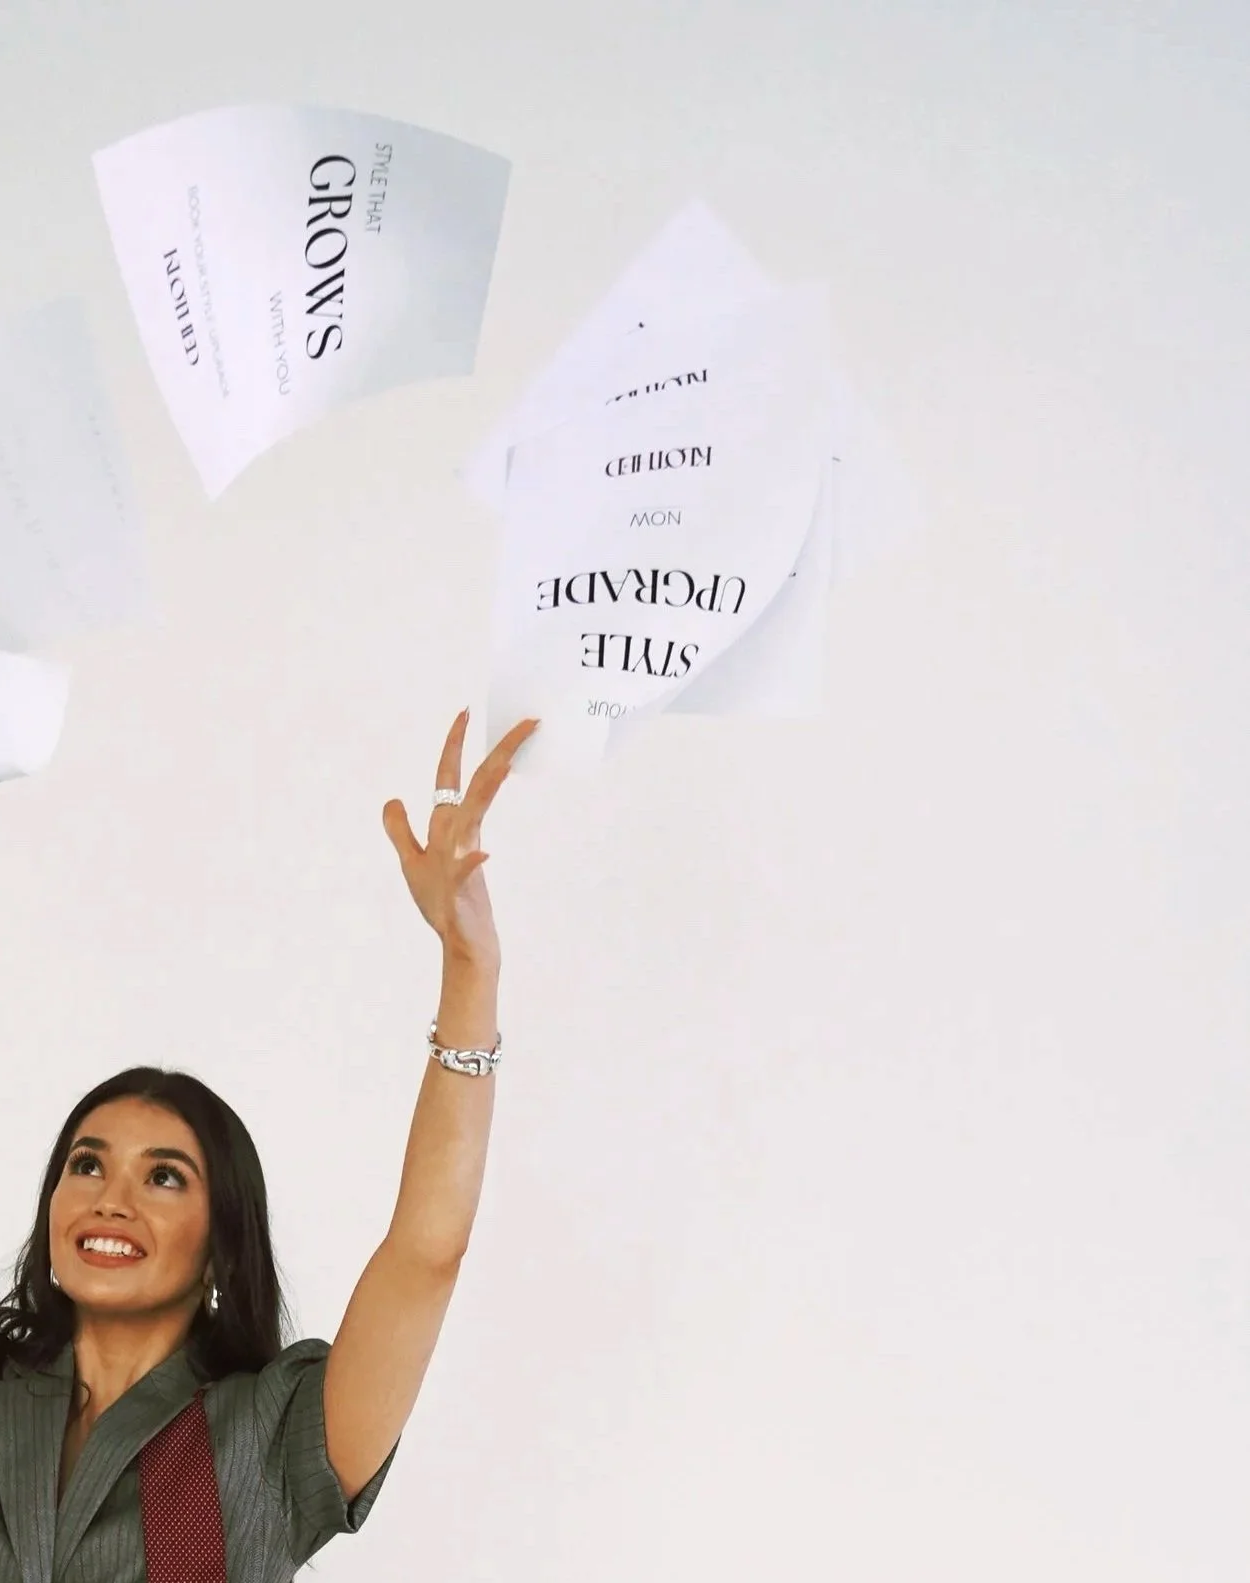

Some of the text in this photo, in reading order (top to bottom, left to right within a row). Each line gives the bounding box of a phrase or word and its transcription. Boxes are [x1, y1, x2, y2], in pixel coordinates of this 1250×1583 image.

[365, 142, 394, 235] STYLE THAT
[305, 154, 356, 361] GROWS
[268, 289, 291, 396] WITH YOU
[629, 510, 682, 529] NOW
[536, 569, 746, 615] UPGRADE
[580, 632, 700, 678] STYLE
